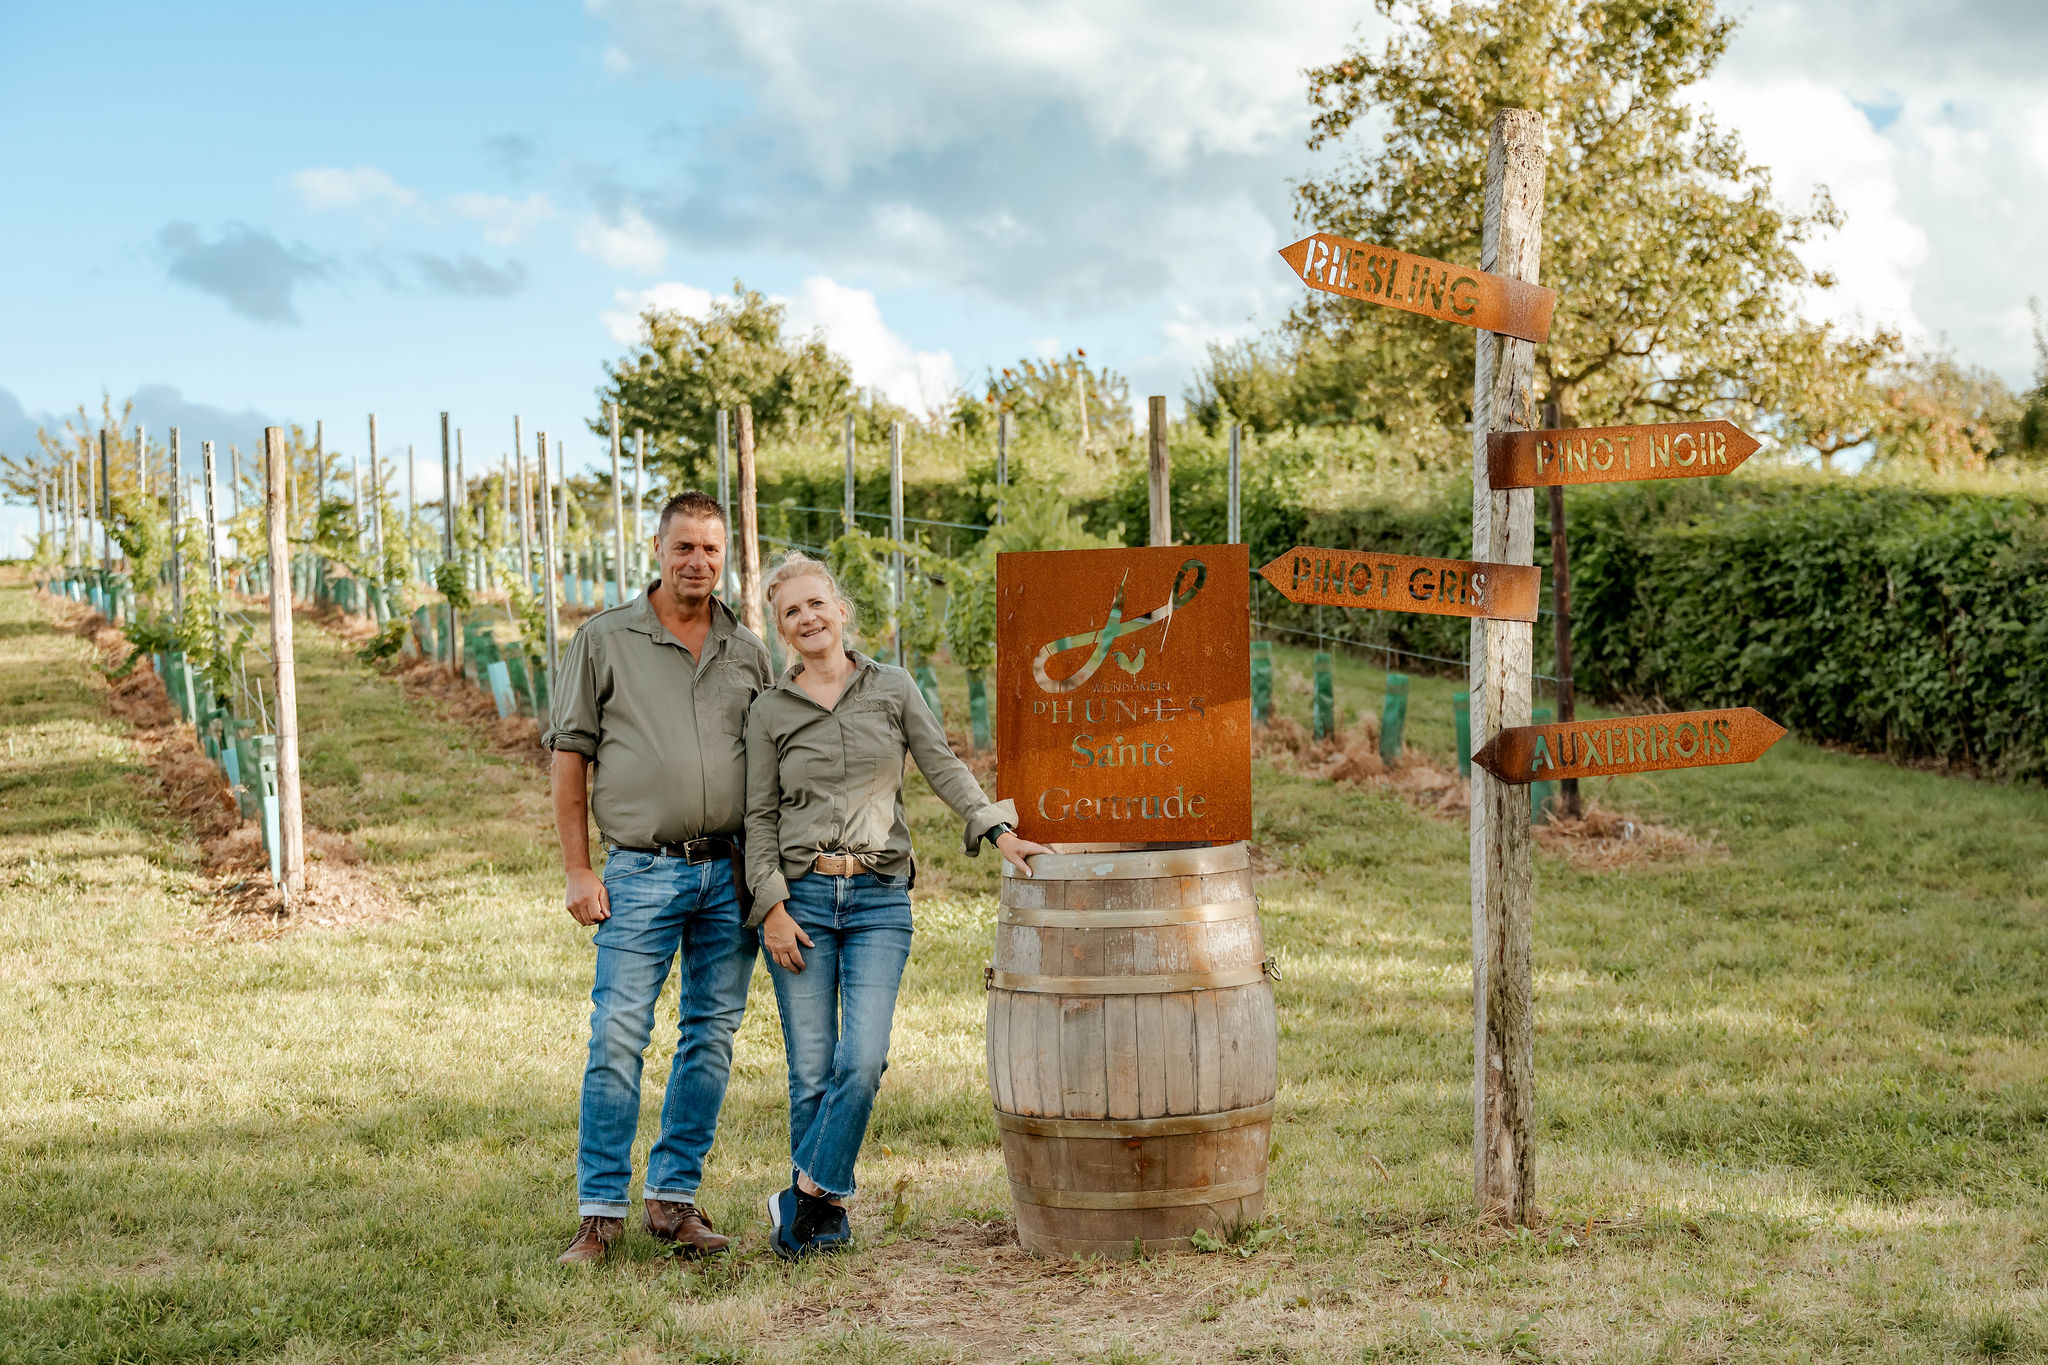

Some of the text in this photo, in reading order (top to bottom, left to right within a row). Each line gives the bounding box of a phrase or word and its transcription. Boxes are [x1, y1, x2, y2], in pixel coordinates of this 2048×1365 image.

[1303, 238, 1480, 317] RIESLING
[1536, 431, 1727, 474] PINOT NOIR
[1292, 556, 1486, 606] PINOT GRIS
[1071, 734, 1174, 768] Santé
[1531, 718, 1731, 772] AUXERROIS
[1038, 785, 1208, 822] Gertrude
